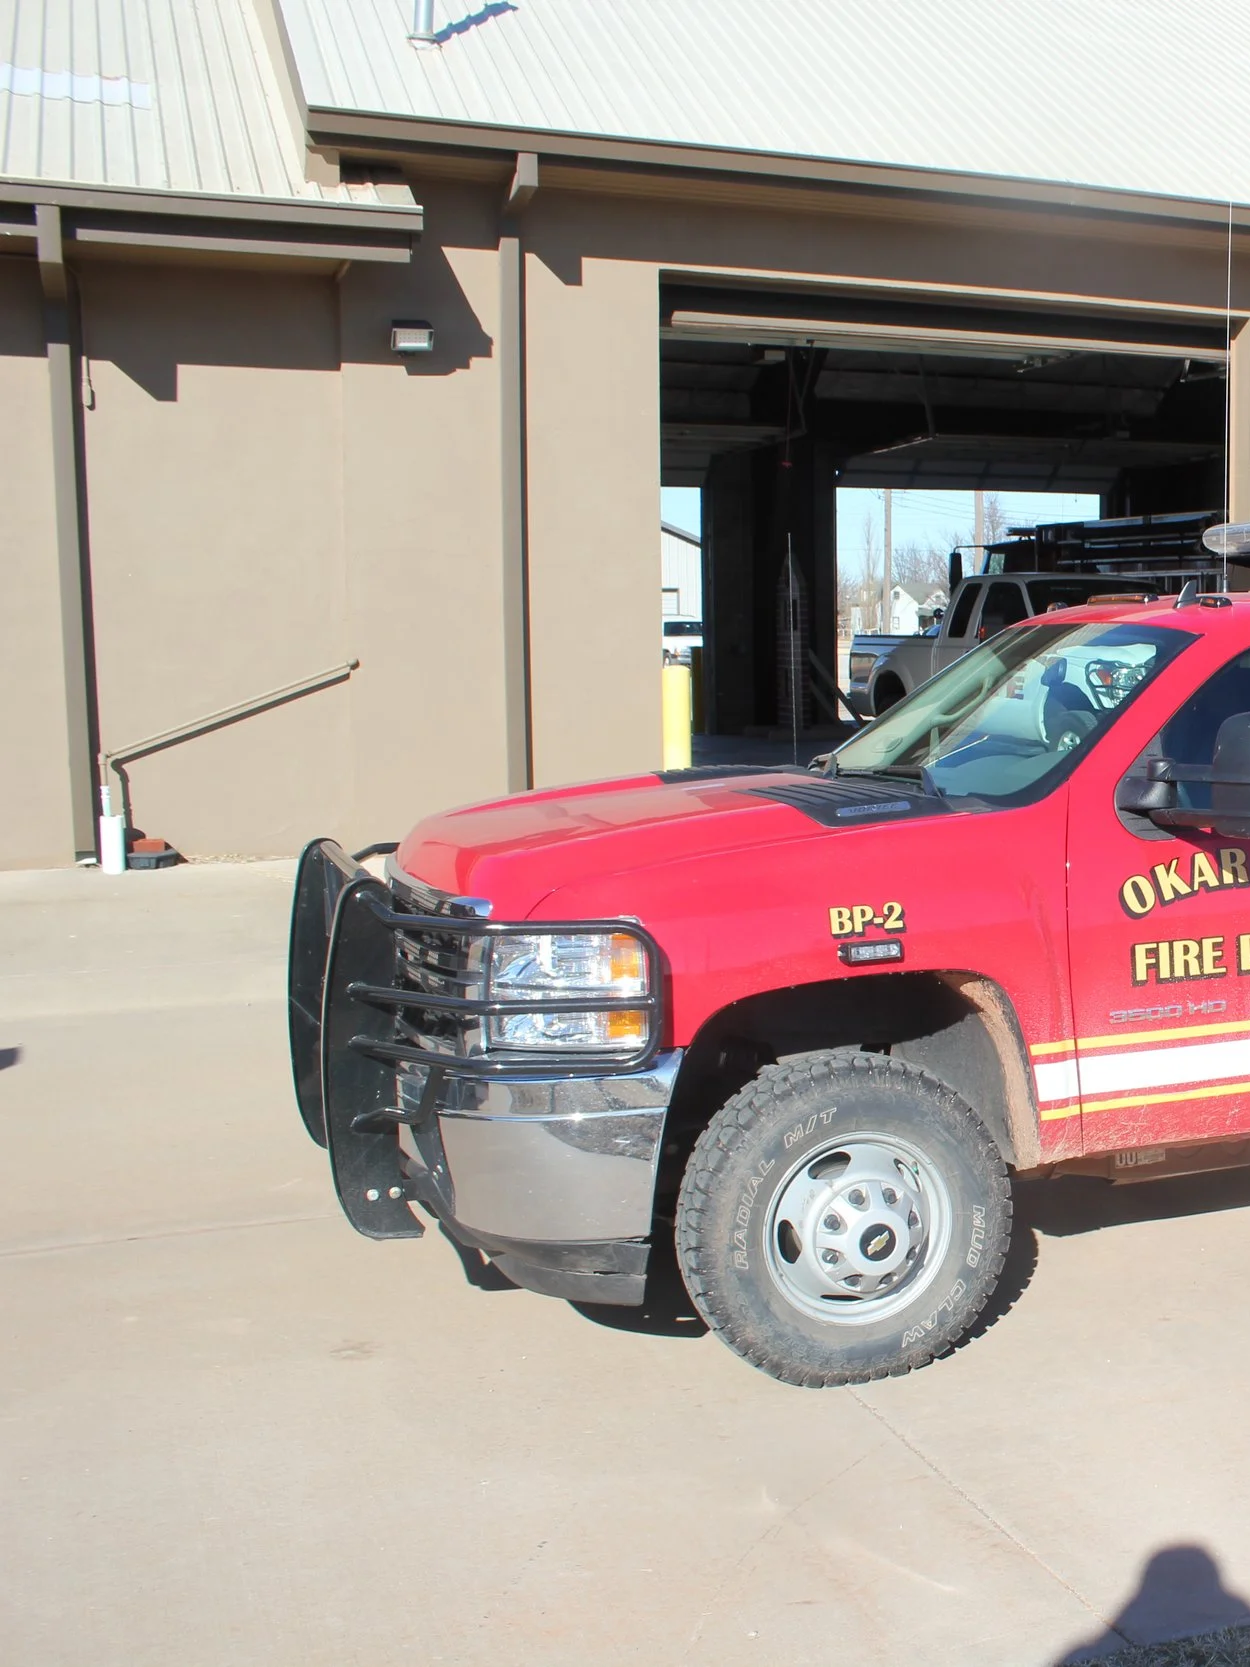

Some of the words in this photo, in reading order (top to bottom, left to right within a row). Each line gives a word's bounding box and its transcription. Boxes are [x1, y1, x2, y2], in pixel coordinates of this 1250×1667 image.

[829, 901, 906, 939] BP-2
[1131, 935, 1227, 986] FIRE
[1109, 1004, 1182, 1024] 3500
[1187, 1000, 1226, 1016] HD
[735, 1158, 776, 1270] RADIAL
[784, 1107, 837, 1149] M/T
[966, 1205, 986, 1268] MUD
[902, 1279, 966, 1348] CLAW
